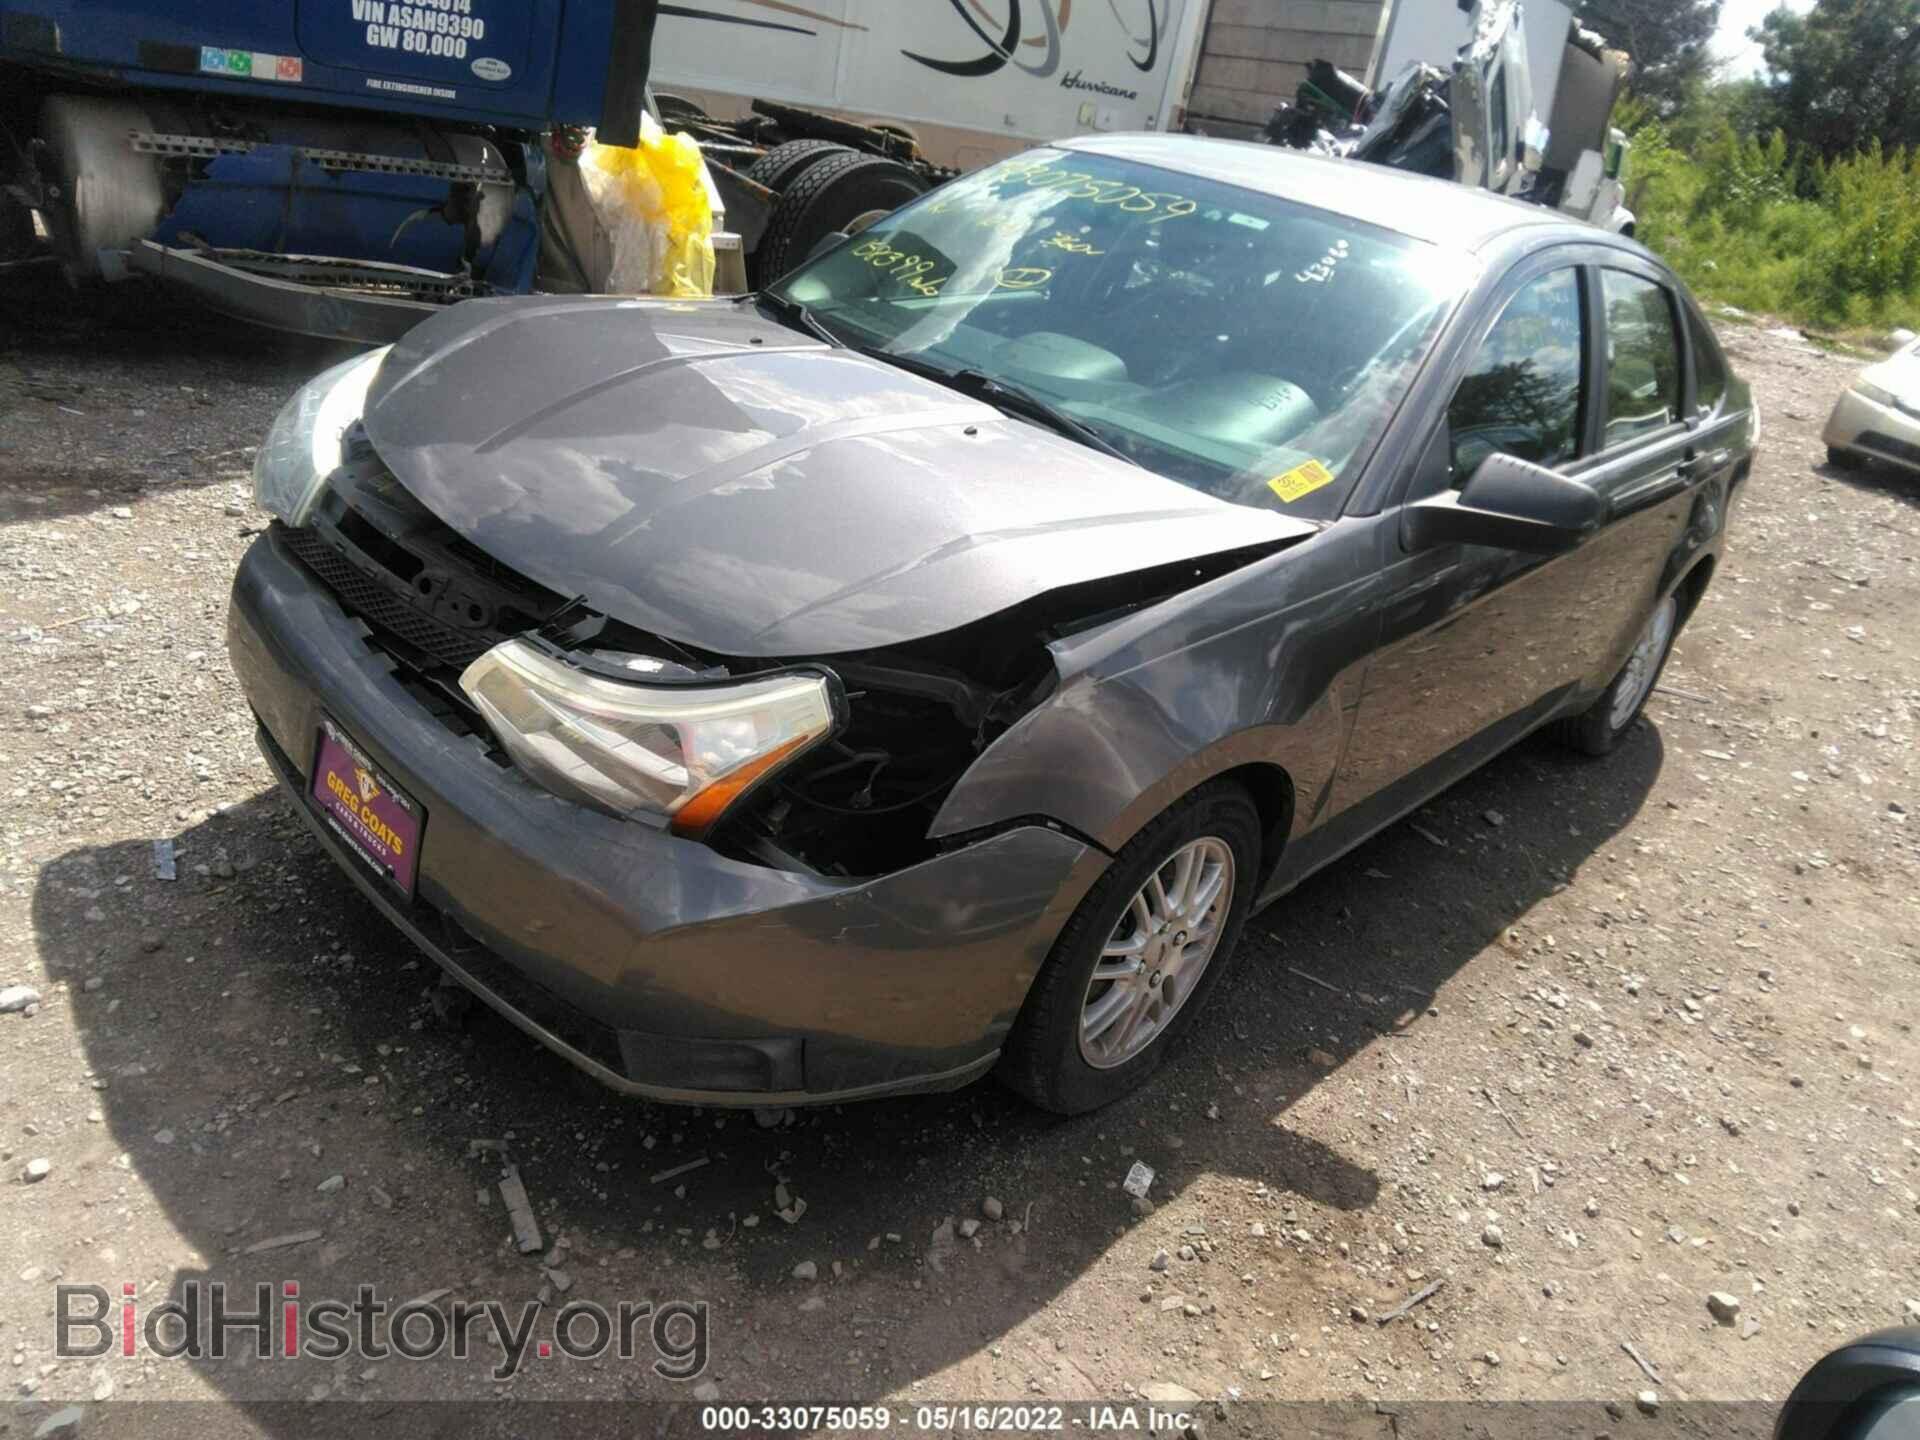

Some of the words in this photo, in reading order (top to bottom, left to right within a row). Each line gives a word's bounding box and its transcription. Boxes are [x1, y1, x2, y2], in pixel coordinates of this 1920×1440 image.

[352, 0, 385, 23] VIN
[388, 4, 485, 40] ASAH9390
[366, 24, 399, 49] GW
[402, 29, 467, 59] 80,000
[1060, 69, 1138, 100] Hurricane
[327, 770, 360, 812] GREG
[360, 805, 404, 855] COATS
